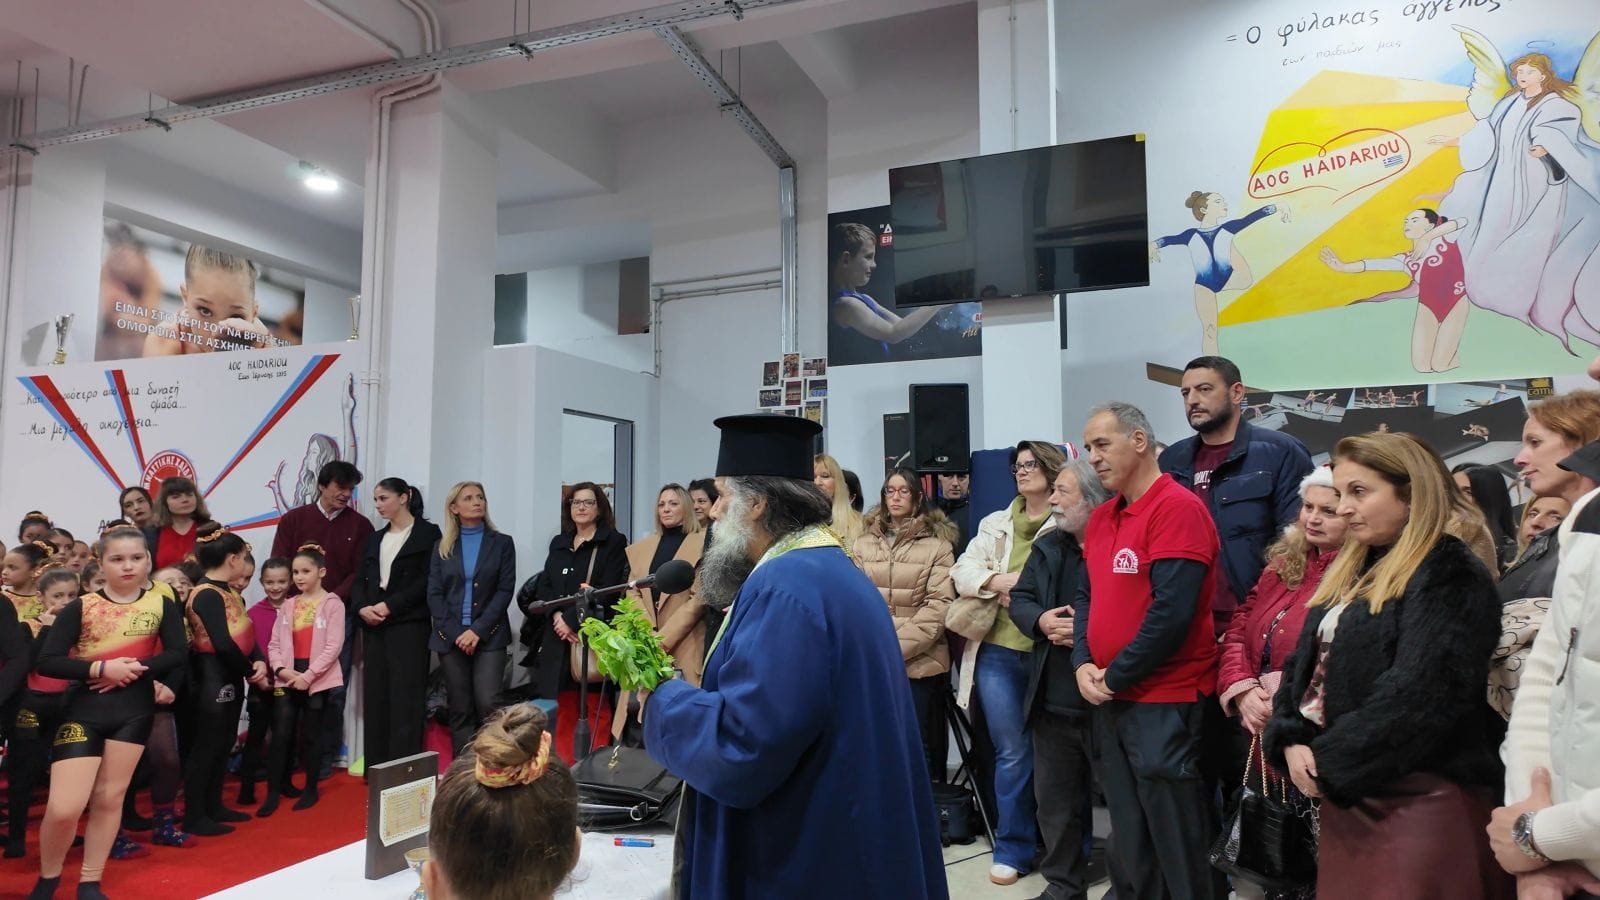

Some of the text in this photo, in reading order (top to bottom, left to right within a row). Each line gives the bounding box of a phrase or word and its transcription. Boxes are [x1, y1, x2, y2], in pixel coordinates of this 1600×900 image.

[1277, 8, 1380, 47] φύλακας
[1253, 139, 1400, 193] AOG HAIDARIOU
[115, 301, 149, 318] ΕΙΝΑΙ
[151, 309, 174, 322] ΣΤΟ
[176, 316, 201, 329] ΧΕΡΙ
[203, 321, 225, 334] ΣΟΥ
[227, 327, 242, 339] ΝΑ
[244, 331, 272, 346] ΒΡΕΙΣ
[117, 318, 177, 340] ΟΜΟΡΦΙΑ
[179, 331, 204, 345] ΣΤΙΣ
